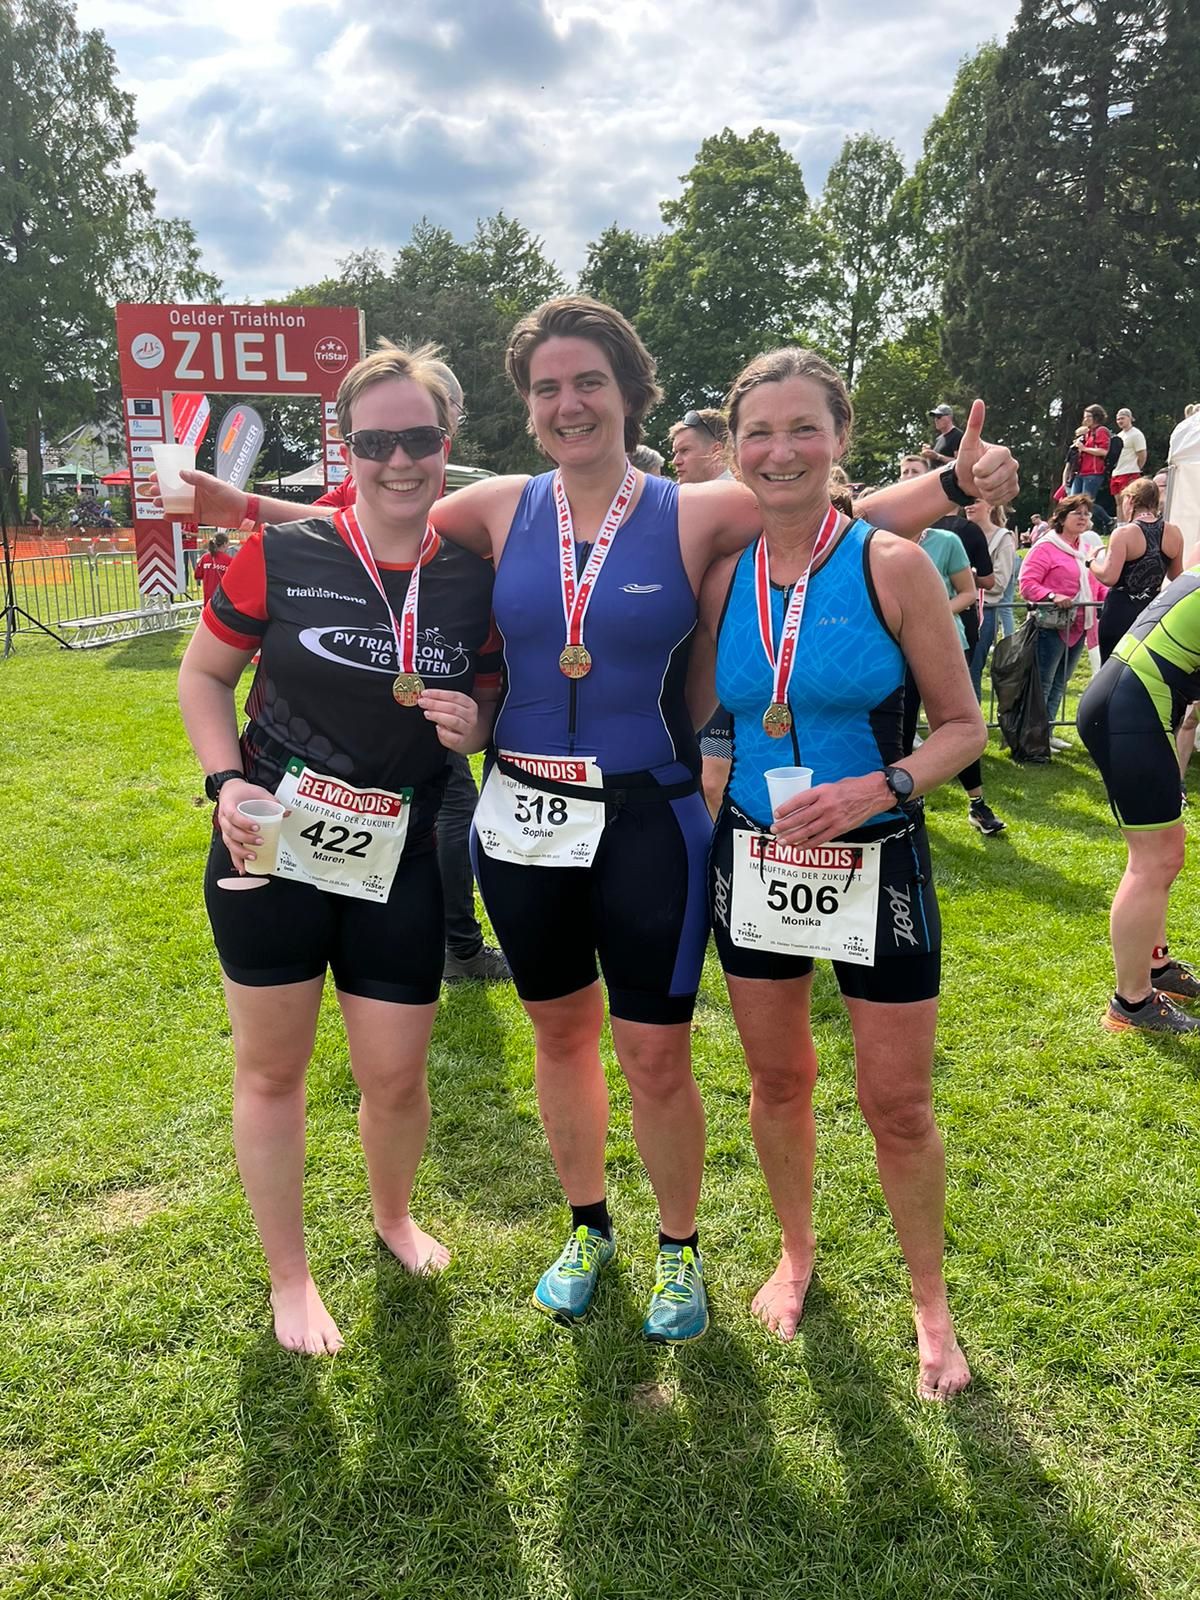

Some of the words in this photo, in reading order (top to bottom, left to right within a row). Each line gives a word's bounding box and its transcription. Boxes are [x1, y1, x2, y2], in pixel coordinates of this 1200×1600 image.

[170, 310, 224, 326] Oelder
[230, 310, 305, 327] Triathlon
[172, 331, 307, 381] ZIEL
[316, 352, 347, 360] TriStar
[558, 490, 571, 540] OELDE
[584, 545, 606, 586] SWIM
[602, 500, 626, 538] BIKE
[562, 545, 574, 581] 2023
[286, 587, 367, 605] triathlon.one
[784, 591, 803, 640] SWIM
[333, 631, 356, 646] PV
[359, 636, 445, 660] TRIALON
[370, 651, 391, 665] TG
[502, 757, 577, 780] MONDIS
[290, 798, 301, 808] IM
[303, 802, 341, 821] AUFTRAG
[344, 815, 359, 825] DER
[361, 817, 395, 829] ZUKUNFT
[514, 794, 568, 826] 518
[300, 820, 373, 858] 422
[522, 827, 553, 839] Sophie
[312, 851, 345, 864] Maren
[750, 862, 759, 870] IM
[762, 865, 798, 878] AUFTRAG
[802, 872, 818, 880] DER
[822, 873, 862, 881] ZUKUNFT
[767, 879, 839, 915] 506
[781, 915, 821, 927] Monika
[737, 929, 762, 939] TriStar
[842, 943, 868, 953] TriStar
